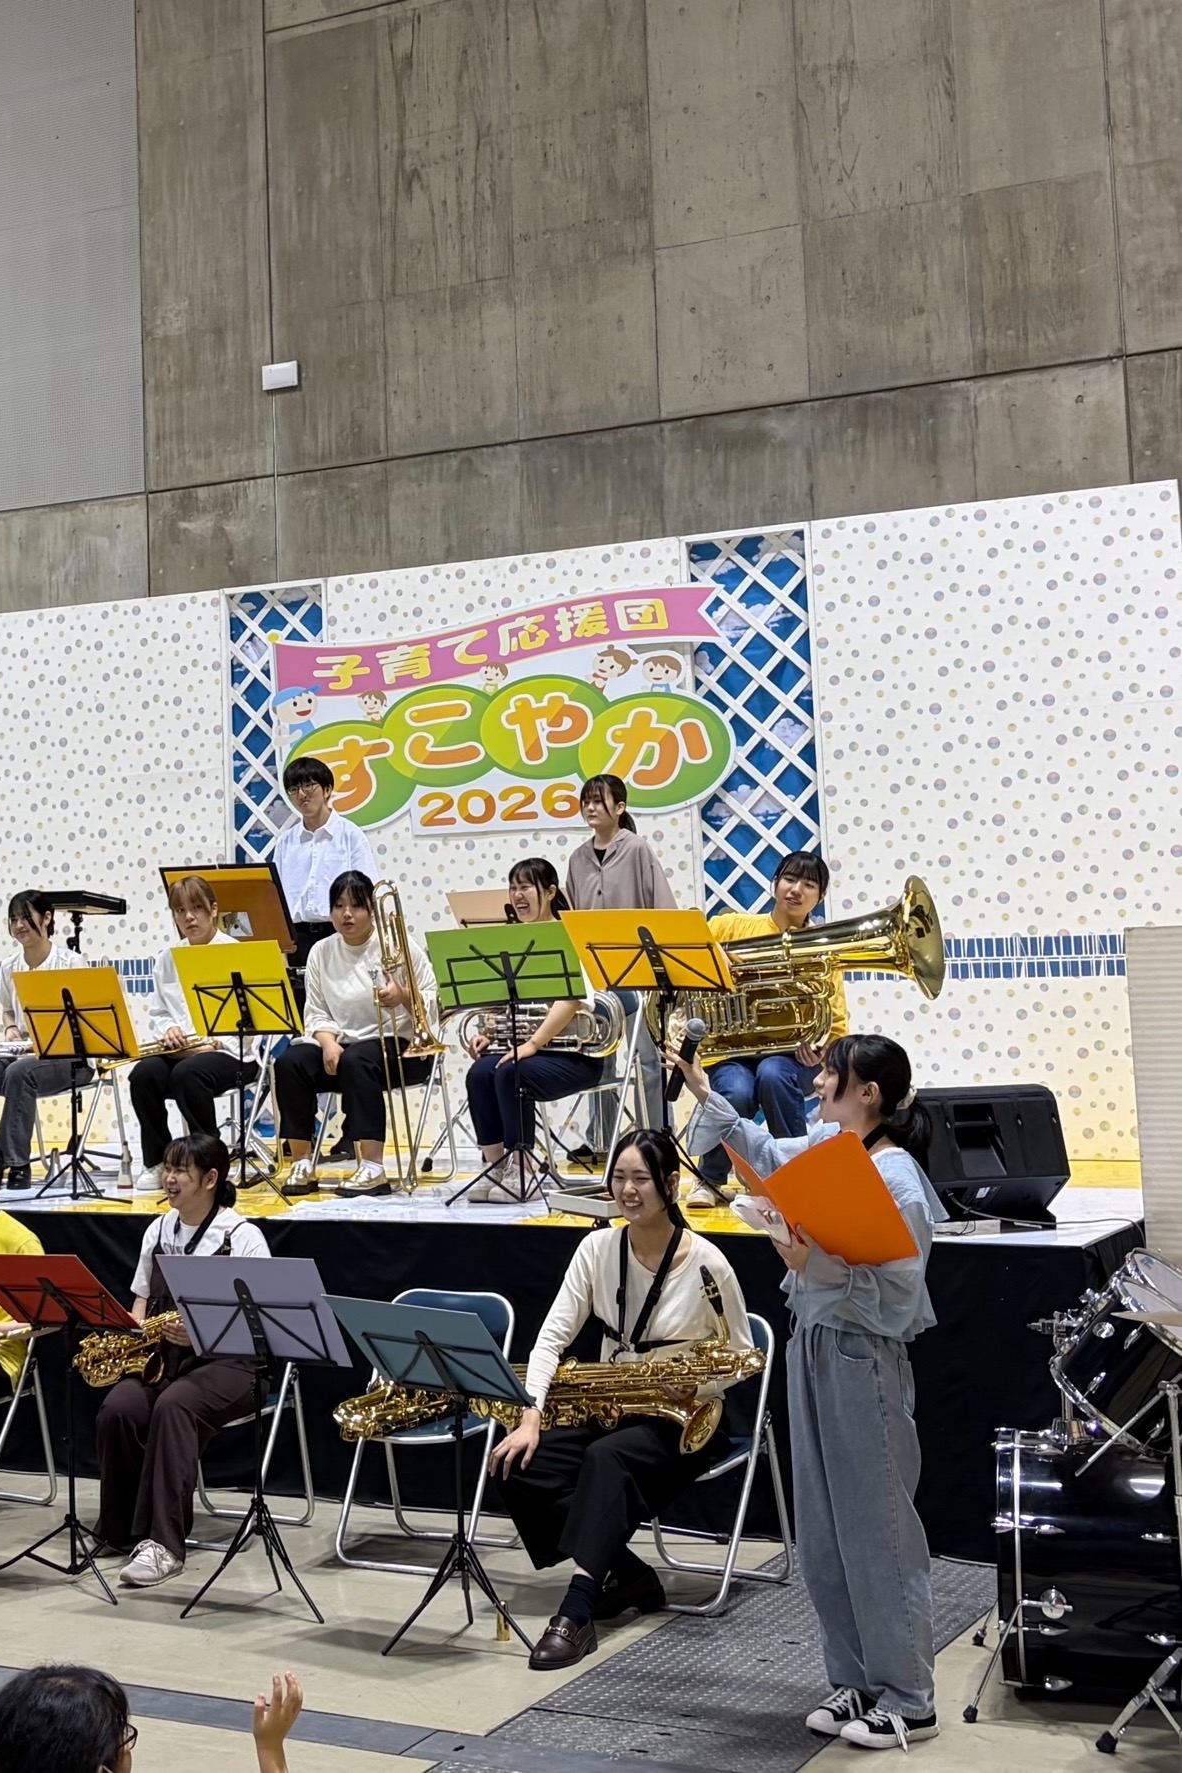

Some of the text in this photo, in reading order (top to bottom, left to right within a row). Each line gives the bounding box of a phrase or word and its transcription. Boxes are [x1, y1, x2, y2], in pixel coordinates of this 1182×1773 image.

[312, 598, 669, 691] 子育て応援団
[303, 692, 712, 814] すこやか
[418, 782, 581, 827] 2026
